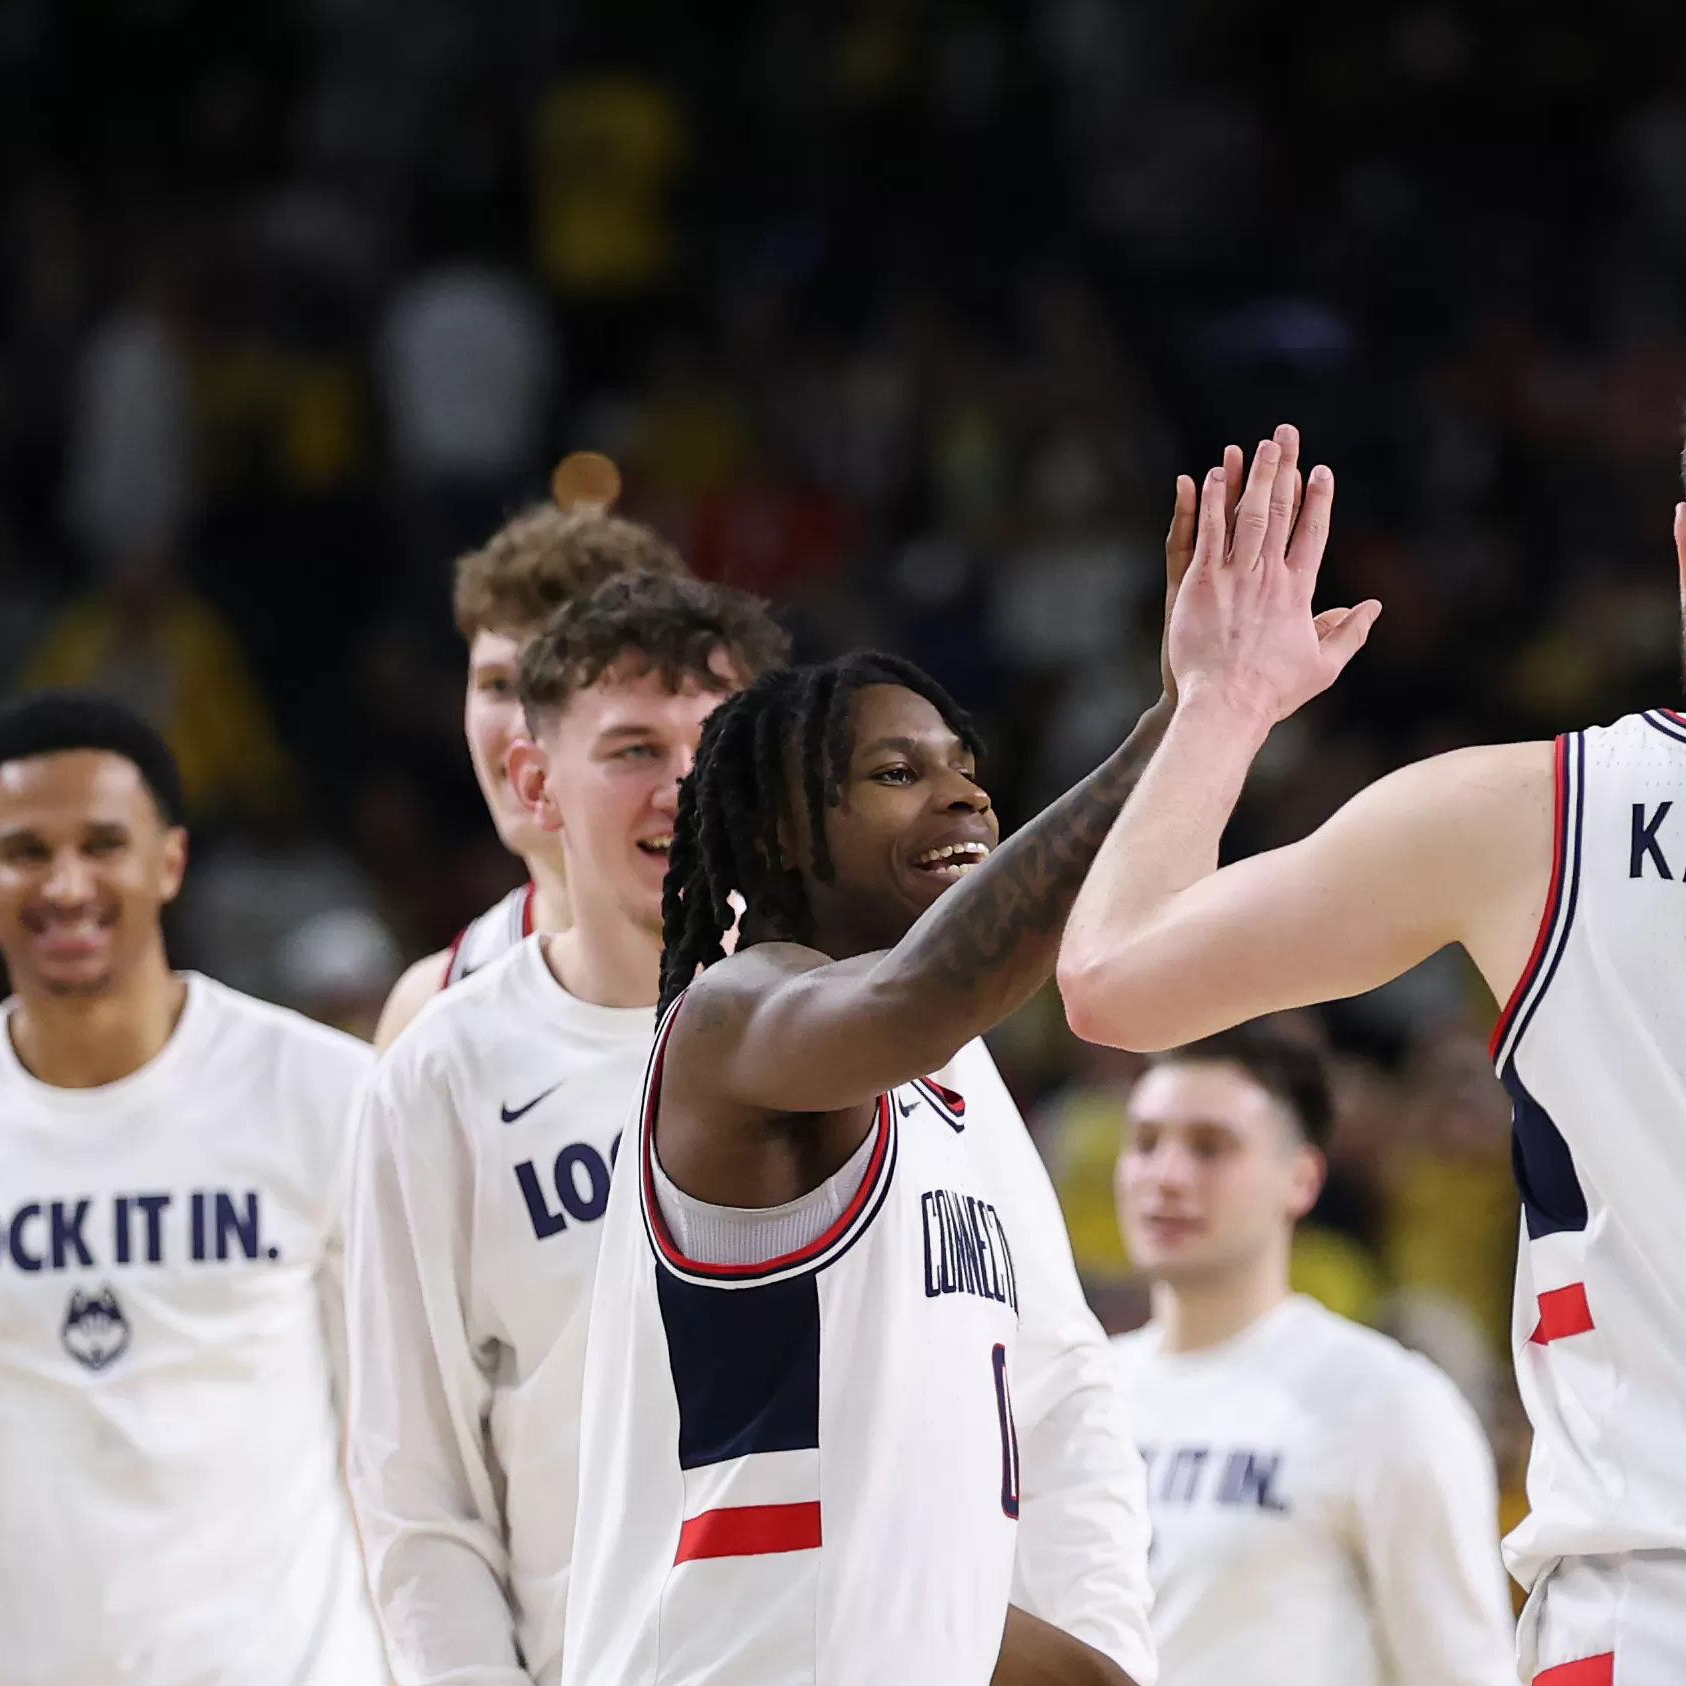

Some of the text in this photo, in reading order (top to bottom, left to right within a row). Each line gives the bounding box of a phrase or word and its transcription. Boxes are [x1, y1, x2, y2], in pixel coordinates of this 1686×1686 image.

[114, 1195, 171, 1264] IT
[191, 1192, 279, 1262] IN.
[514, 1130, 622, 1240] LO
